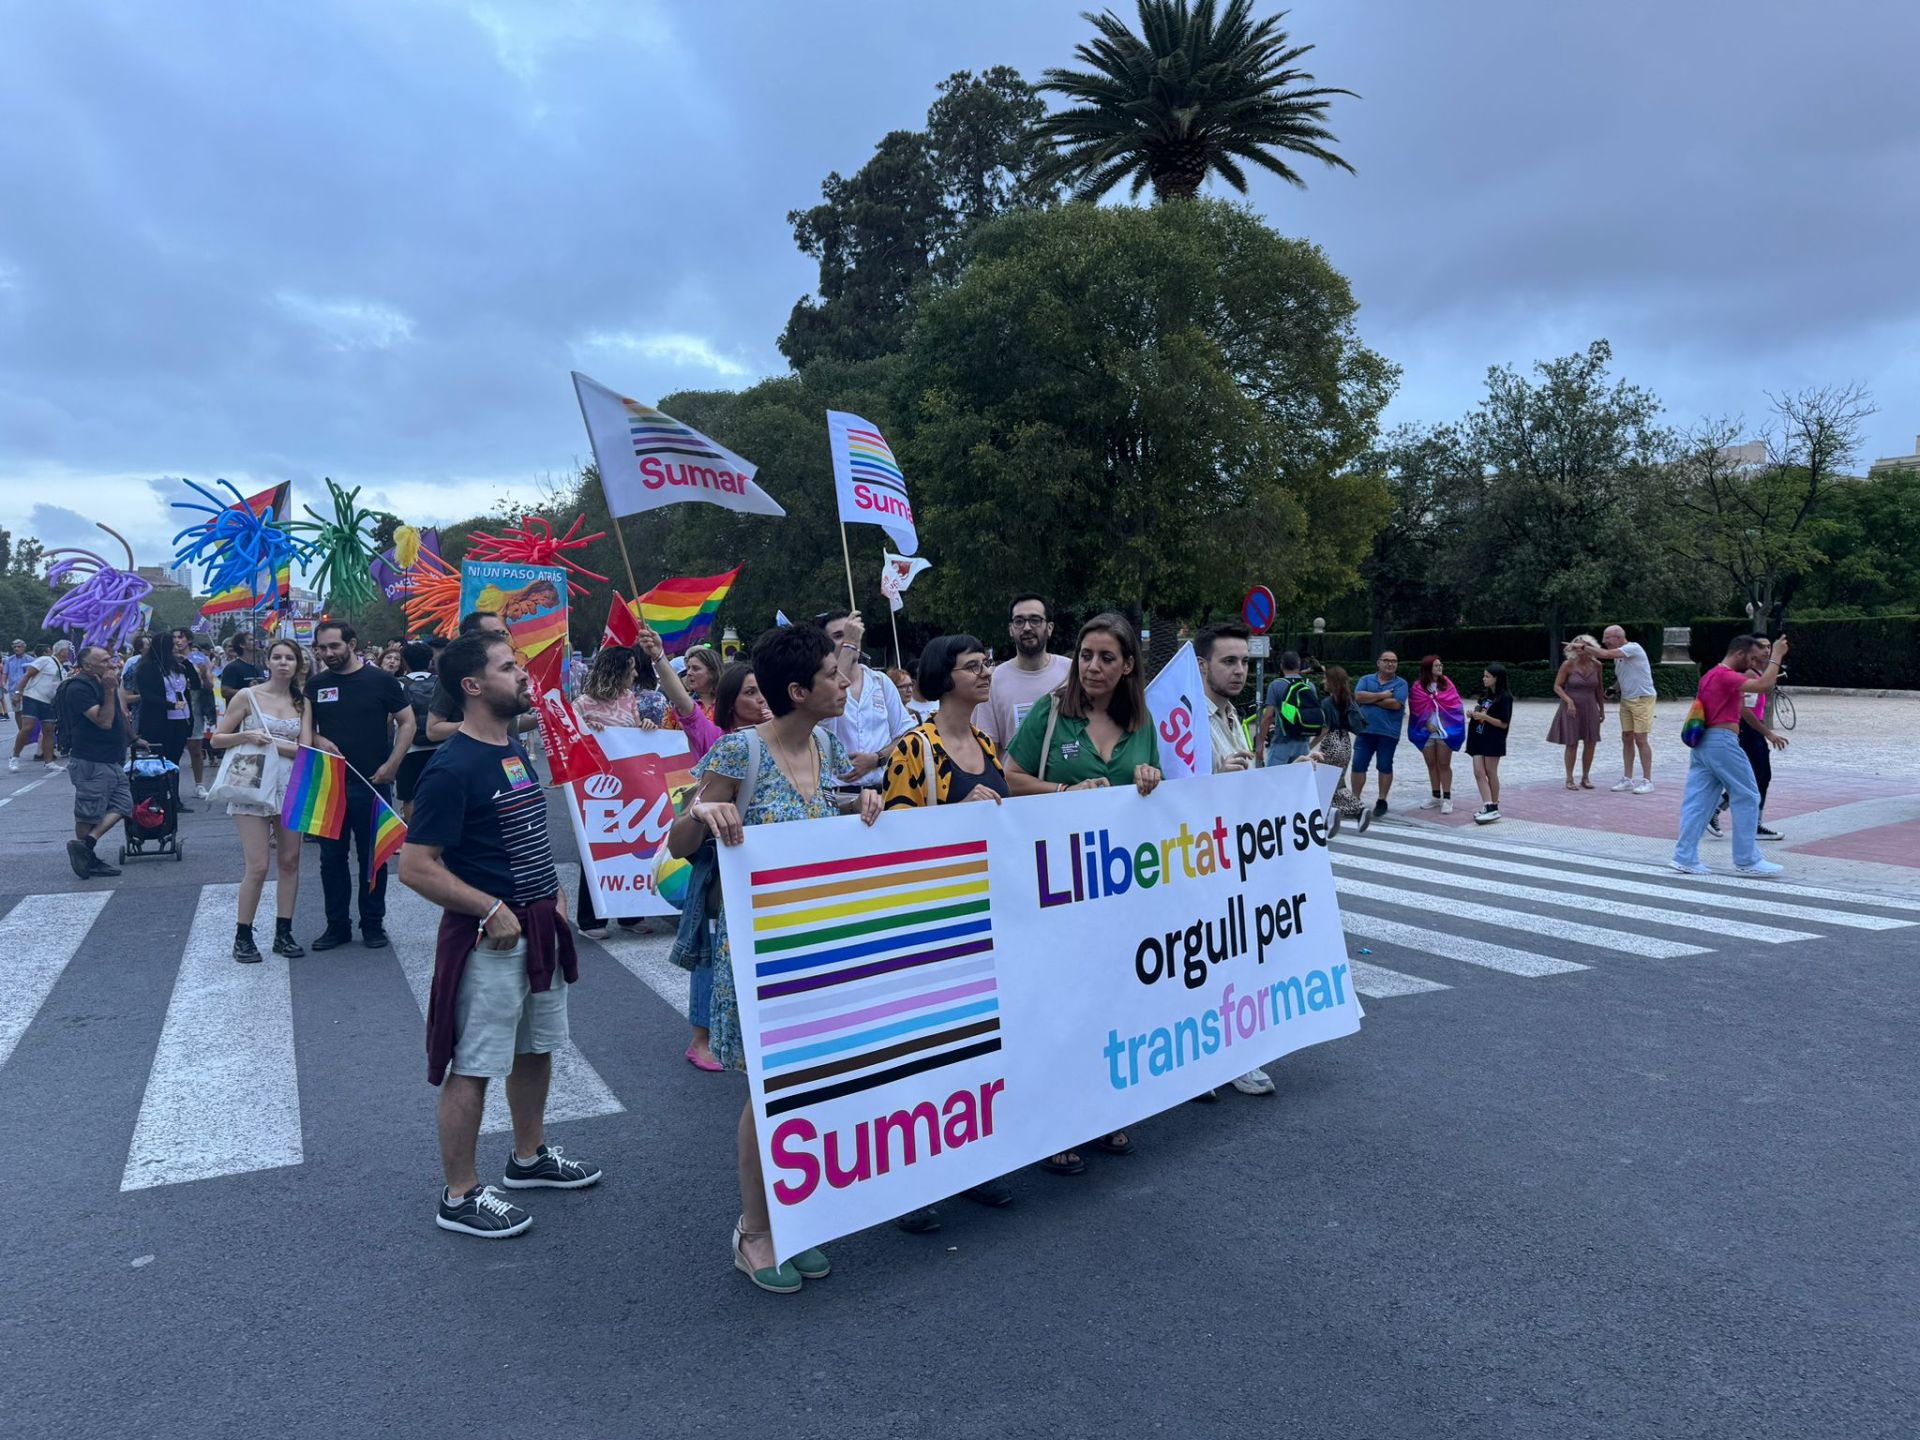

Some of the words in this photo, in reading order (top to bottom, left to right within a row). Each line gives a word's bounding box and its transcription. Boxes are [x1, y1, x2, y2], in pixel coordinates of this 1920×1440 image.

[639, 456, 749, 495] Sumar
[468, 566, 480, 577] NI
[483, 567, 500, 578] UN
[503, 568, 535, 580] PASO
[1034, 816, 1231, 909] Llibertat
[1236, 815, 1287, 882] per
[1135, 894, 1248, 989] orgull
[1255, 893, 1306, 964] per
[1103, 963, 1347, 1090] transformar
[771, 1077, 1005, 1206] Sumar
